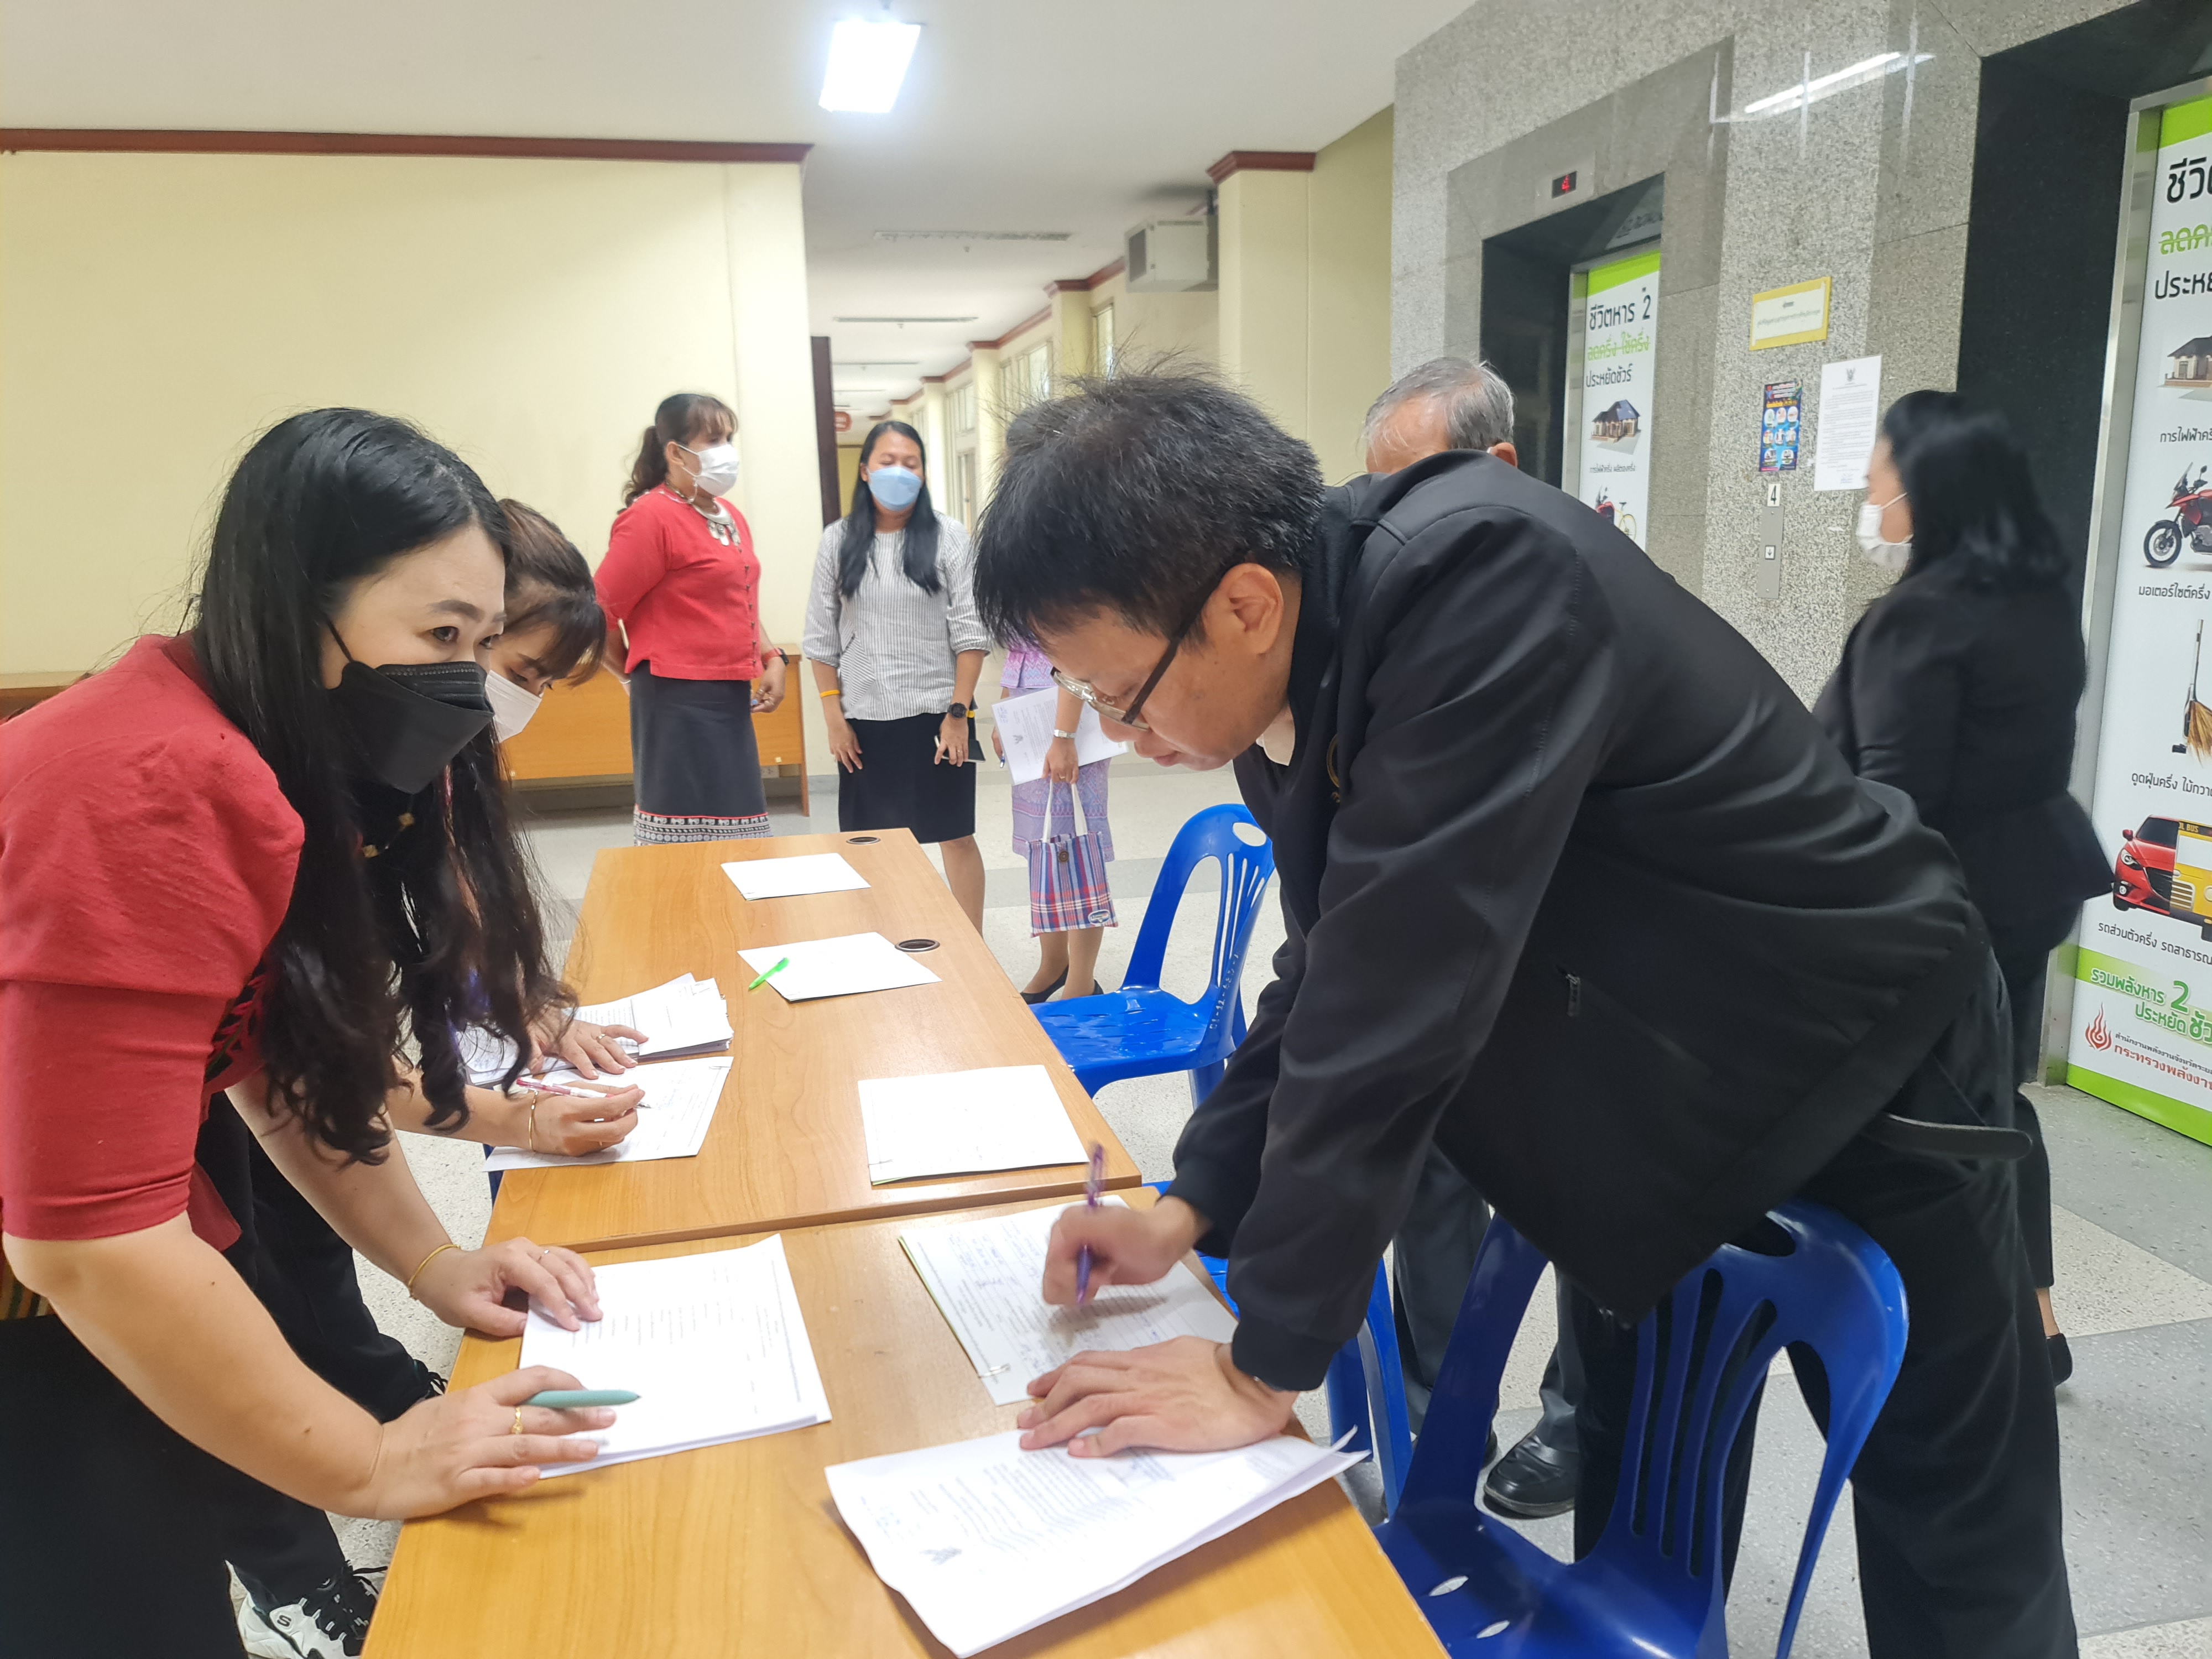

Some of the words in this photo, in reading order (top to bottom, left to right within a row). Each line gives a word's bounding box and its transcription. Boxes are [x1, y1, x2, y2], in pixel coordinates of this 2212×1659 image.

[2167, 156, 2212, 204] ชีวิ
[2158, 224, 2212, 255] ลดค
[1589, 304, 1635, 331] ชีวิตหาร
[1642, 287, 1651, 320] 2
[1588, 334, 1617, 361] ลดครึ่ง
[1621, 327, 1650, 354] ใช้ครึ่ง
[1586, 363, 1633, 388] ประหยัดชัวร์
[1770, 485, 1777, 505] 4
[2131, 773, 2178, 790] ดูดฝุ่นครึ่ง
[2186, 823, 2199, 833] BUS
[2098, 922, 2157, 948] รถส่วนตัวครึ่ง
[2091, 969, 2164, 1004] รวมพลังหาร
[2171, 980, 2189, 1013] 2
[2135, 1001, 2187, 1034] ประหยัด
